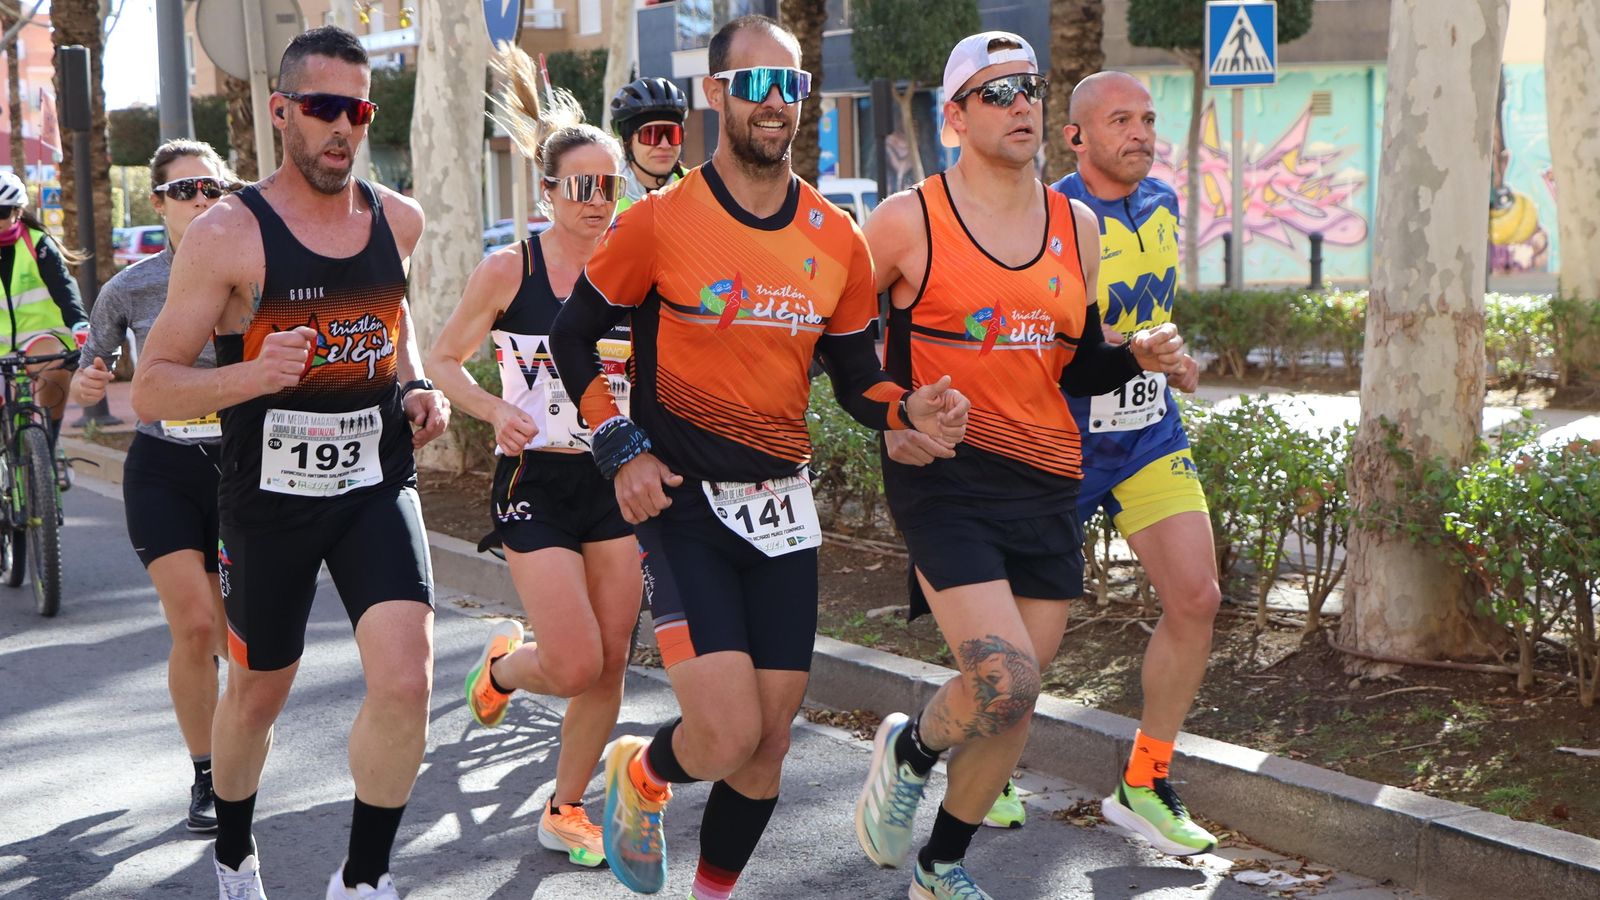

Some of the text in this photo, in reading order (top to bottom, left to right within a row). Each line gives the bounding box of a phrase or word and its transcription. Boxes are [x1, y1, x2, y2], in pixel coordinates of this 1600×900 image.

[290, 286, 325, 301] GOBIK
[755, 284, 806, 299] triatlón
[753, 297, 775, 319] el
[1011, 308, 1051, 321] triatlón
[330, 314, 384, 336] triatlón
[327, 336, 353, 363] el
[1113, 378, 1158, 408] 189
[290, 441, 361, 471] 193
[735, 494, 796, 534] 141
